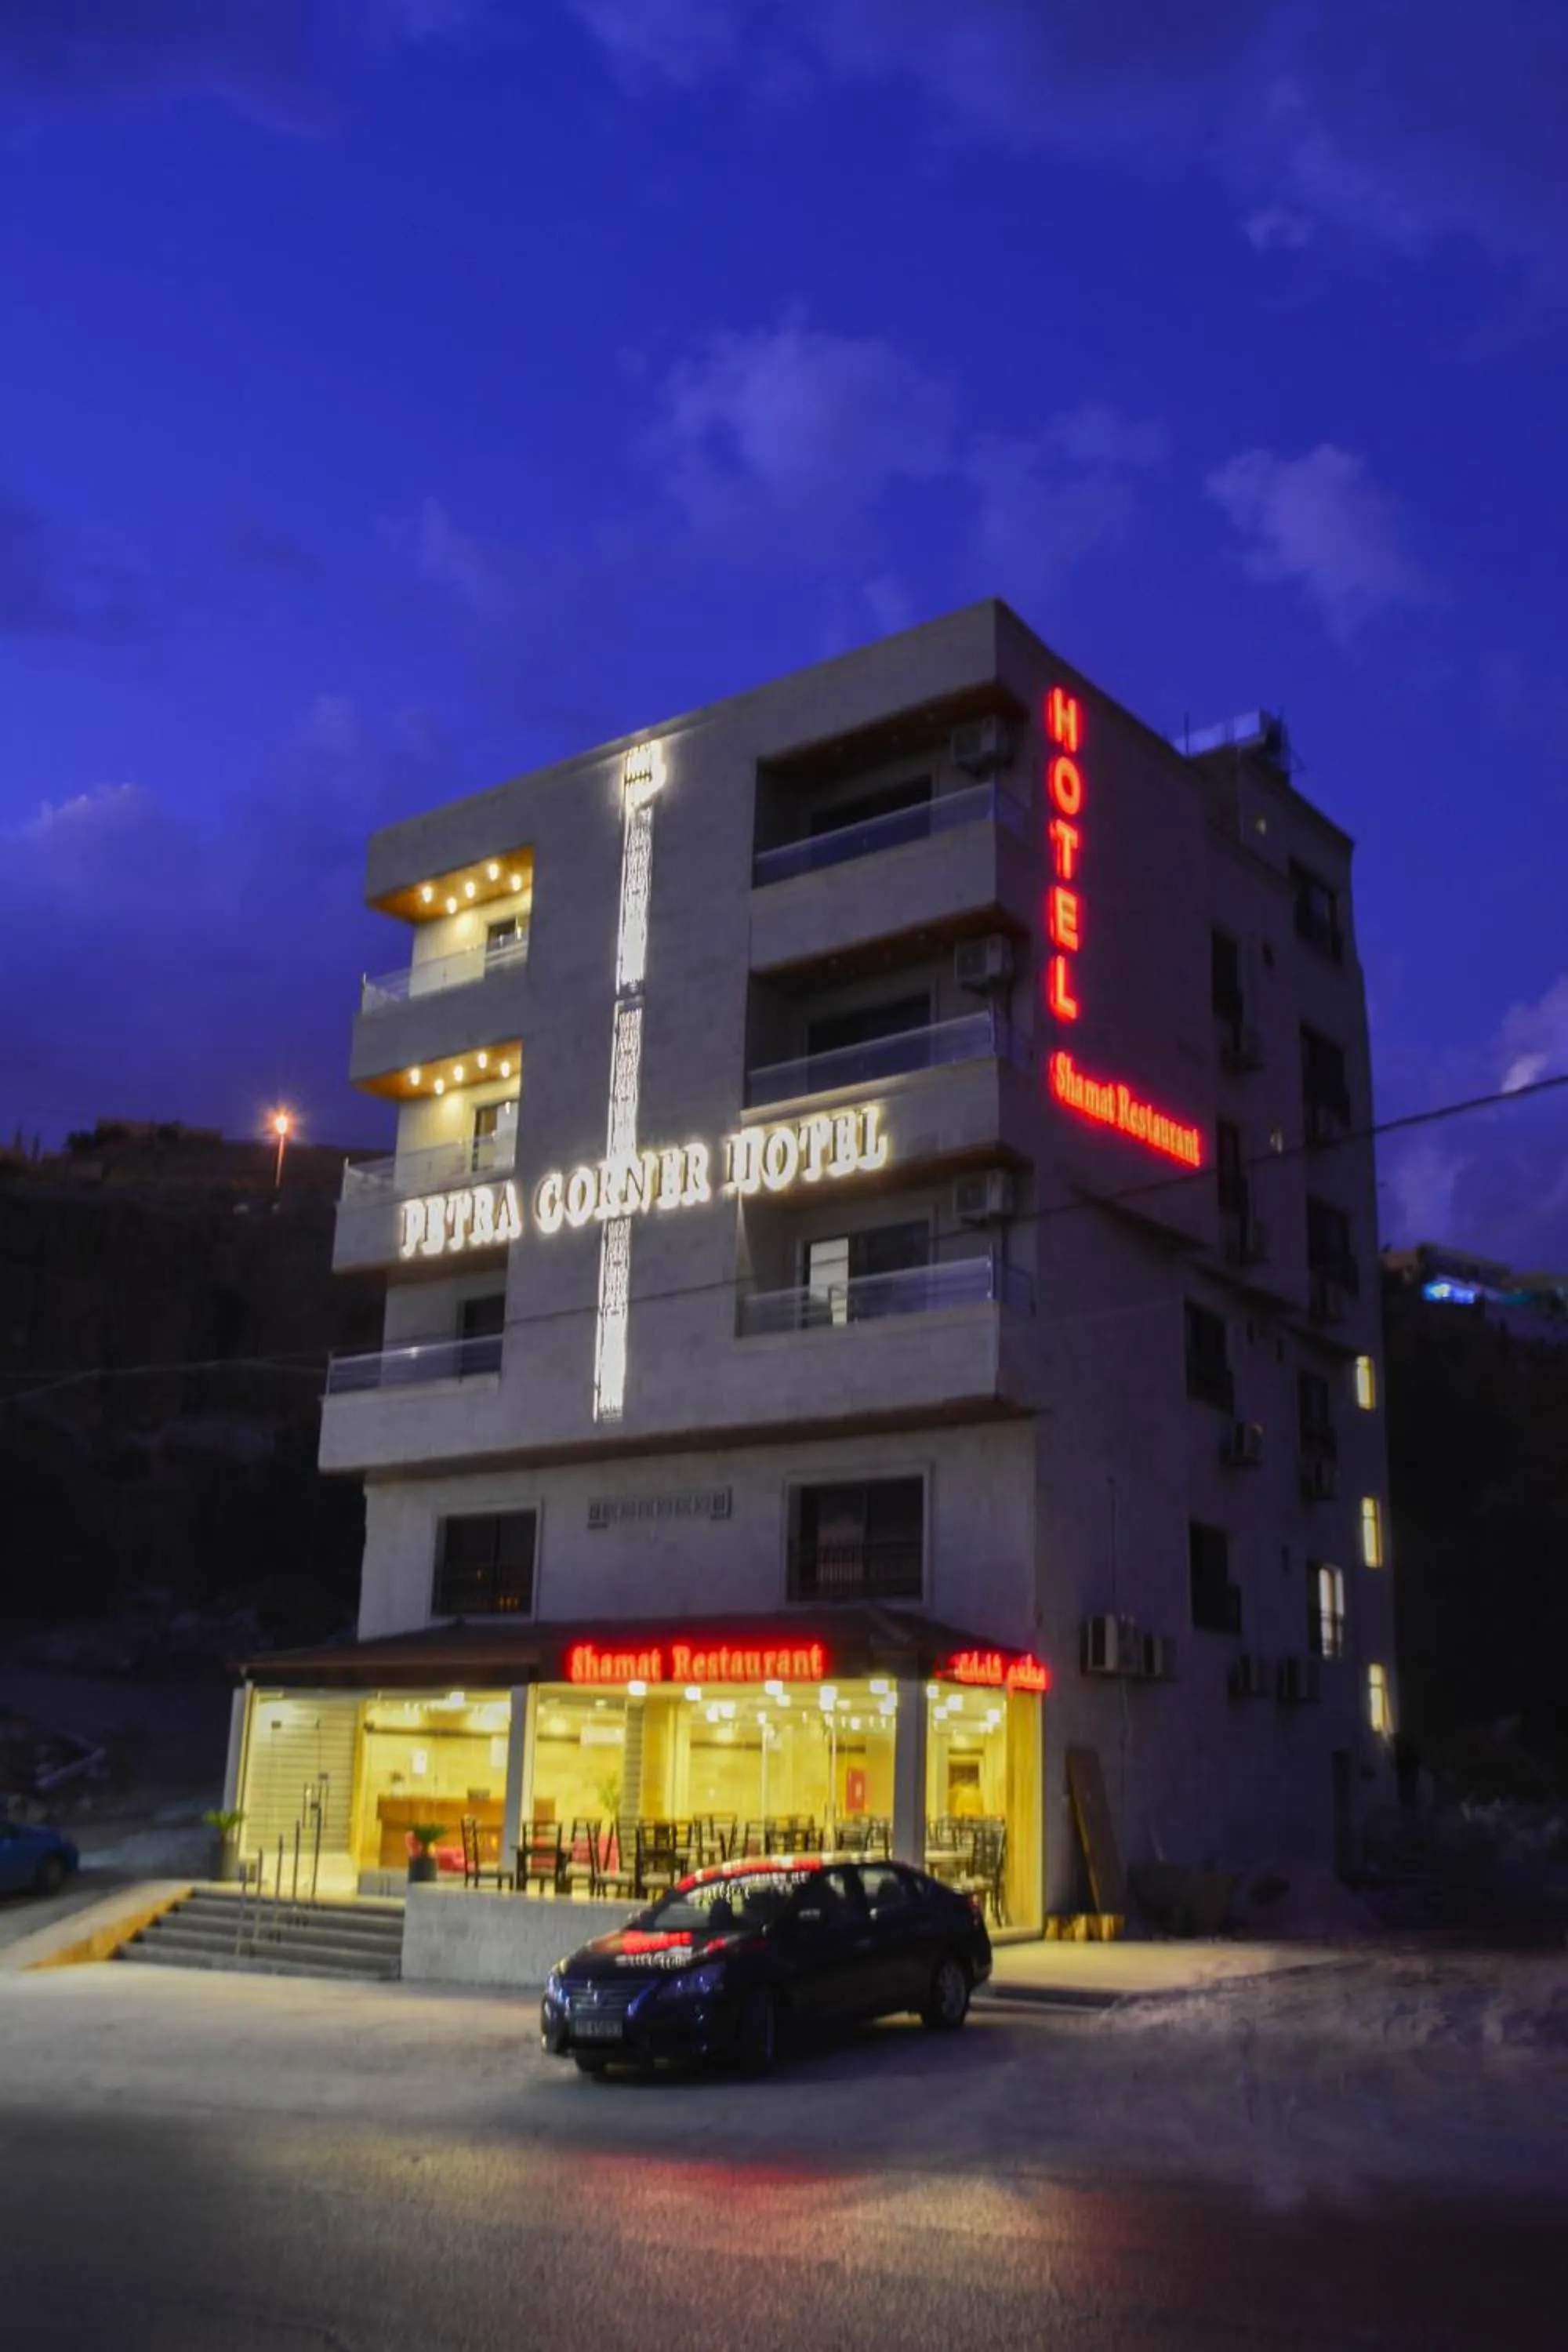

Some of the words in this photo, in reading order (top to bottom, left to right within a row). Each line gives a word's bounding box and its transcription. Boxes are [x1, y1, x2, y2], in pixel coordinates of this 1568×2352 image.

[1048, 686, 1082, 1021] HOTEL
[1052, 1051, 1116, 1124] Shamat
[1116, 1083, 1200, 1167] Restaurant
[401, 1179, 522, 1258] PETRA
[536, 1142, 712, 1234] CORNER
[726, 1104, 888, 1195] HOTEL
[571, 1644, 662, 1682] Shamat
[672, 1643, 823, 1682] Restaurant
